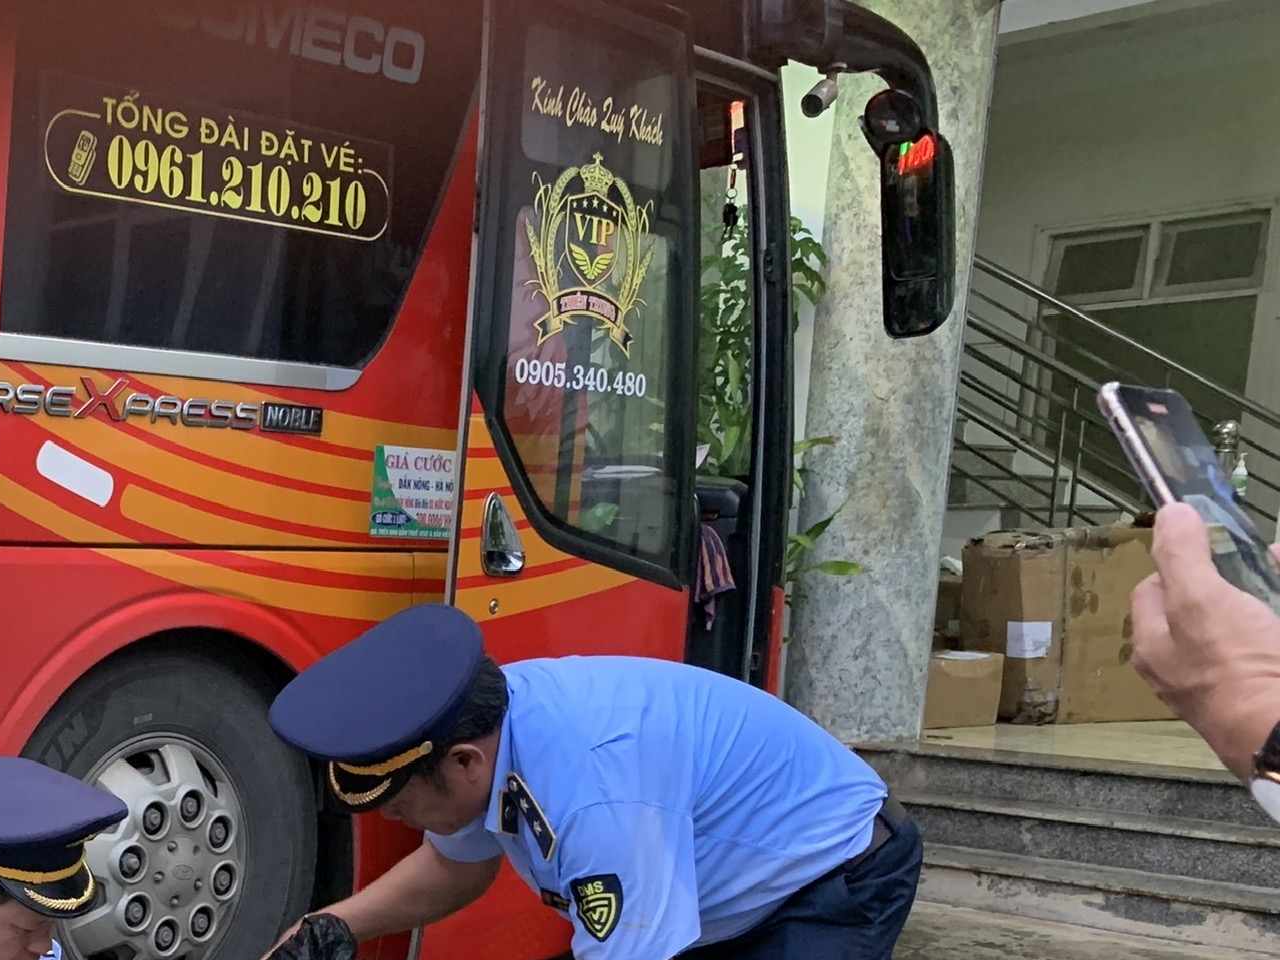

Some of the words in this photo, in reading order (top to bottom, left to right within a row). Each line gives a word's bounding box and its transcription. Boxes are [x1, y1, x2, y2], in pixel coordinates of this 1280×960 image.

[531, 76, 564, 118] Kính
[566, 86, 597, 127] Chào
[629, 104, 663, 146] Khách
[103, 89, 189, 139] TỔNG
[199, 115, 249, 152] ĐÀI
[260, 129, 312, 166] ĐẶT
[320, 140, 363, 174] VÉ:
[107, 134, 367, 230] 0961.210.210
[574, 212, 615, 246] VIP
[515, 358, 646, 397] 0905.340.480
[265, 405, 320, 431] NOBLE
[385, 452, 410, 470] GIÁ
[414, 454, 452, 473] CƯỚC
